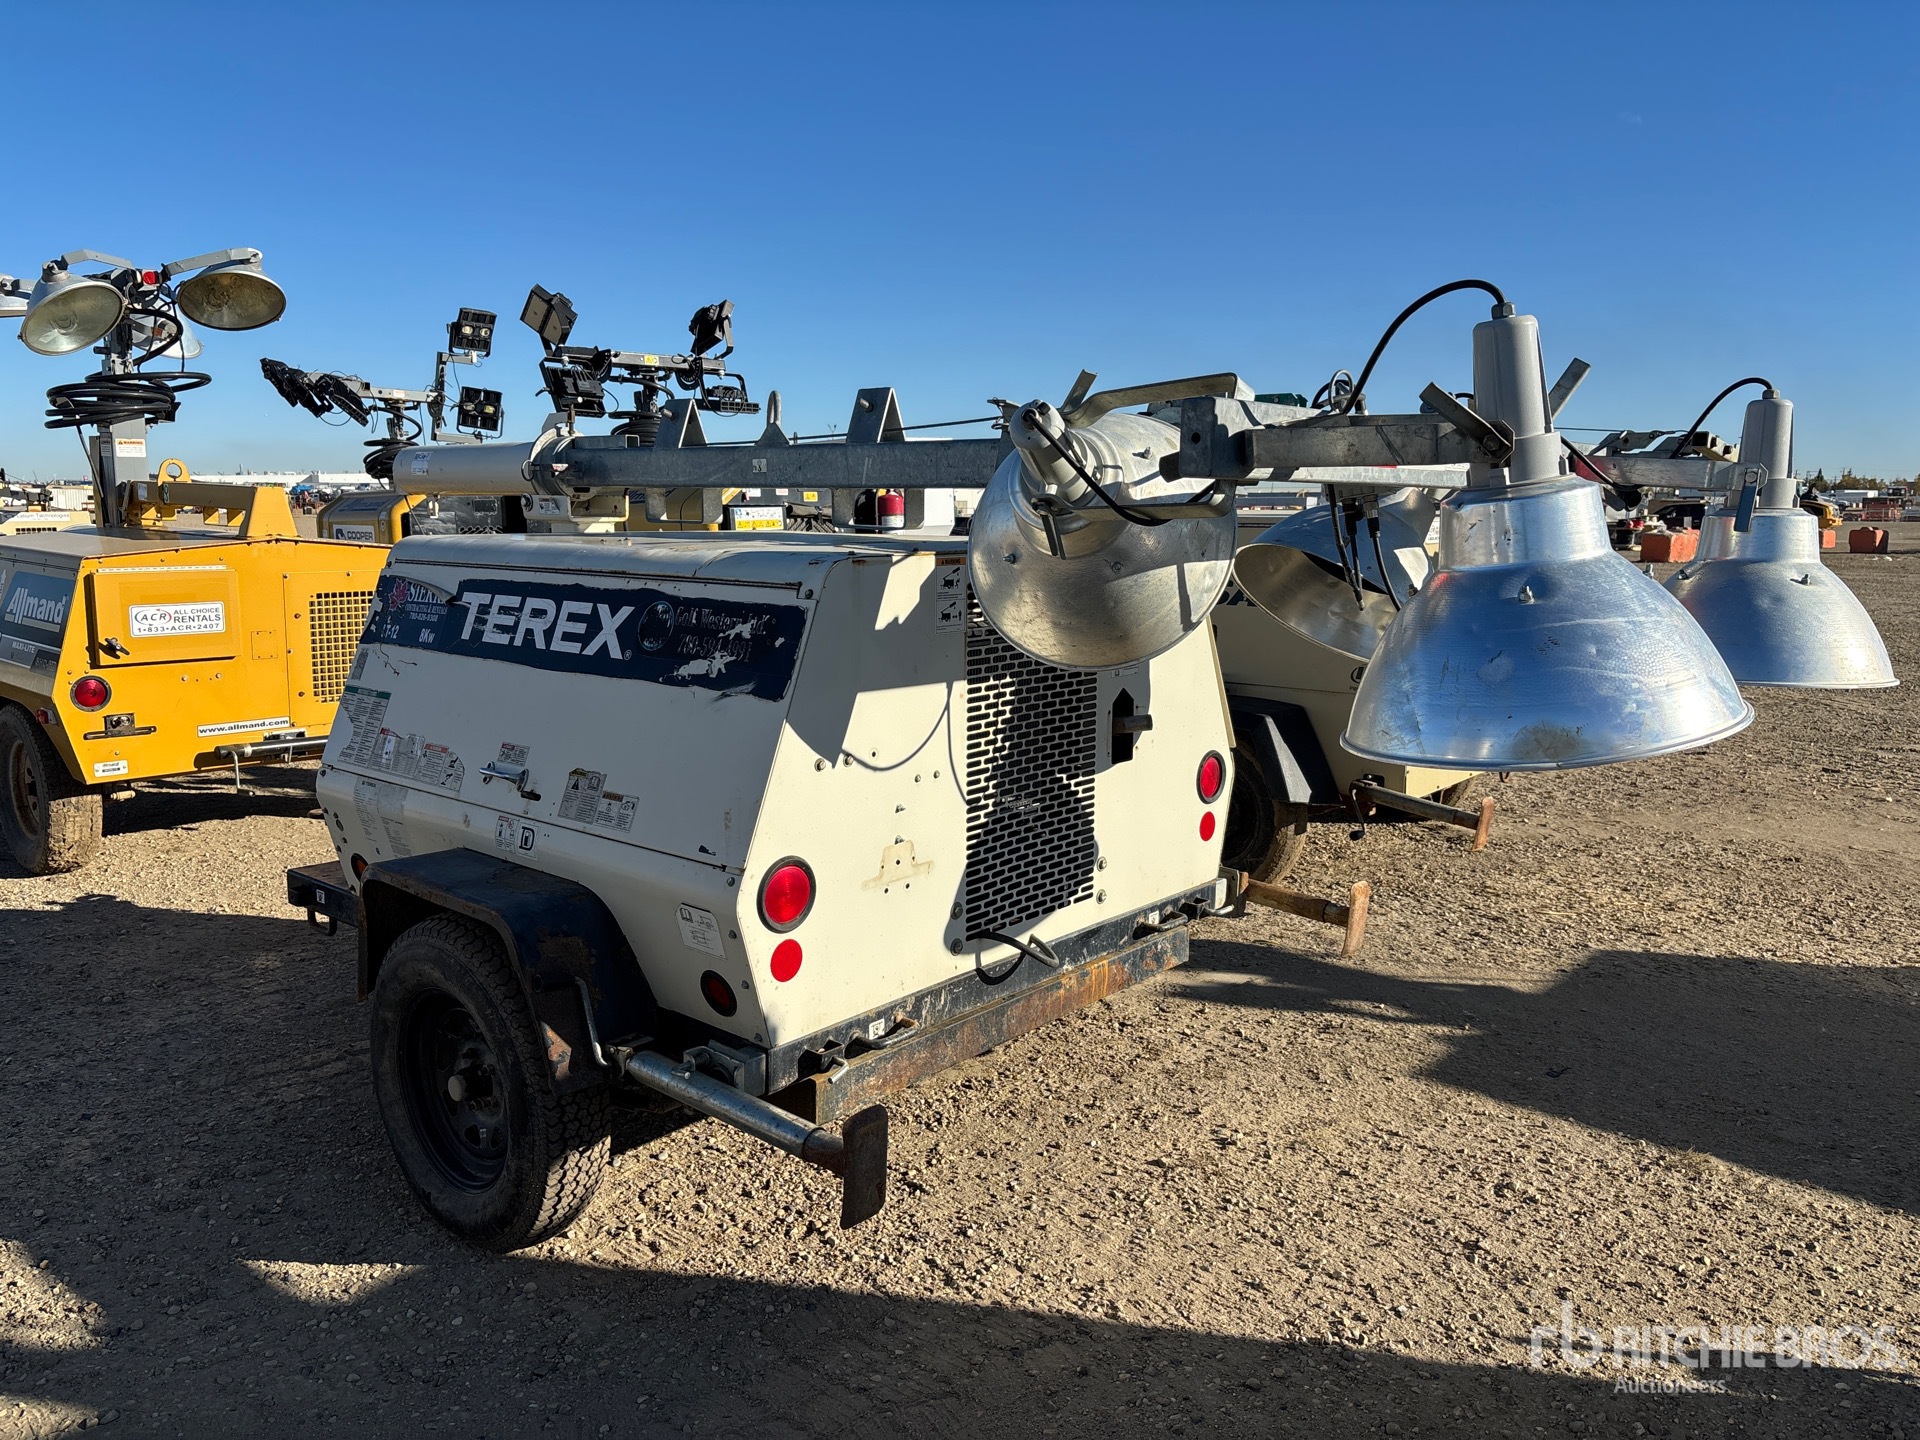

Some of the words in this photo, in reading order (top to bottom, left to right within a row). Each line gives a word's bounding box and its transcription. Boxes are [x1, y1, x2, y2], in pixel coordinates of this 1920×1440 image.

[347, 530, 373, 540] COOPER
[6, 587, 67, 624] Allmand
[190, 607, 220, 615] CHOICE
[140, 612, 167, 622] ACR
[173, 613, 221, 624] RENTALS
[460, 591, 636, 660] TEREX
[12, 640, 36, 654] MAXI-LITE
[198, 719, 289, 734] www.allmand.com
